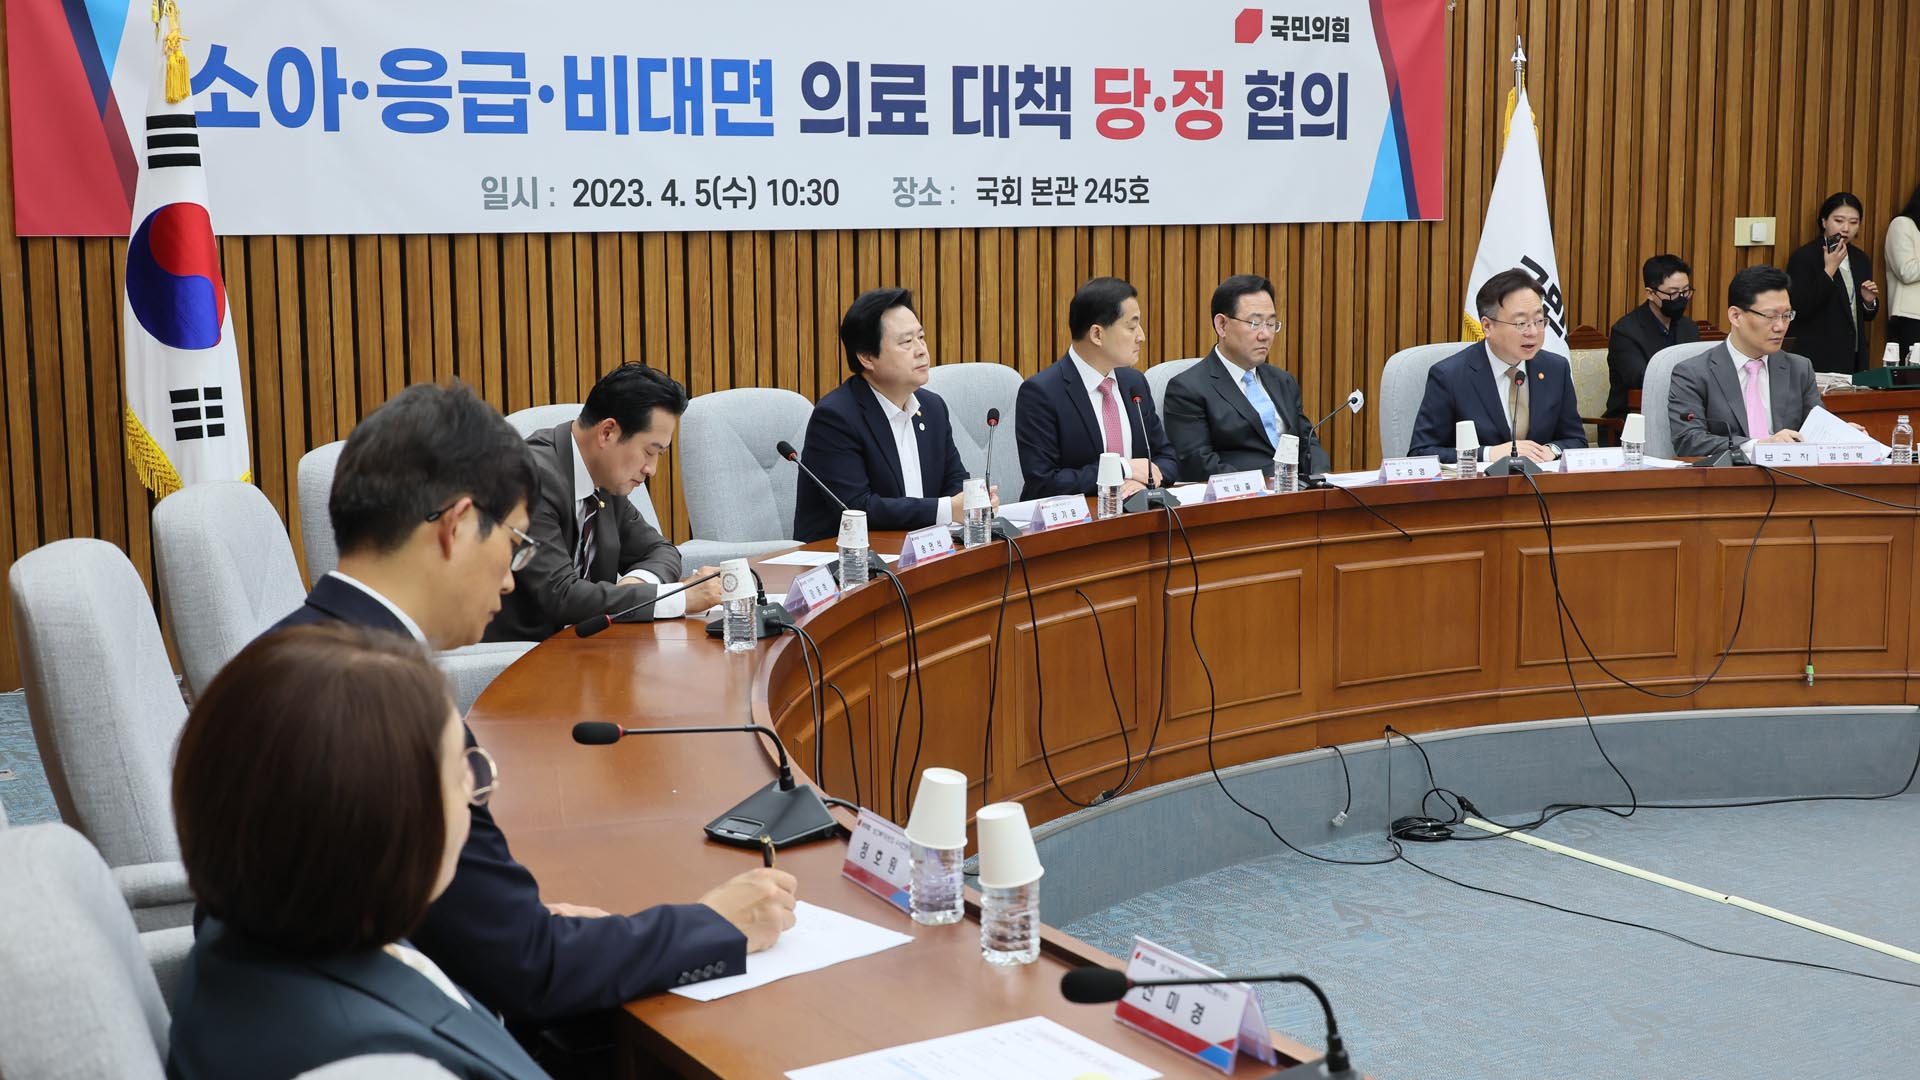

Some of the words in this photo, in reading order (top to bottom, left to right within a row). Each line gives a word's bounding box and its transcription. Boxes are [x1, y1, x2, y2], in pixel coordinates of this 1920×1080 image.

[1269, 15, 1350, 44] 국민의힘
[800, 60, 930, 138] 의료
[951, 63, 1072, 141] 대책
[1094, 67, 1224, 141] 당·정
[1244, 69, 1349, 141] 협의
[481, 175, 538, 211] 일시
[572, 178, 653, 208] 2023.
[660, 178, 686, 207] 4.
[694, 175, 757, 211] 5(수)
[766, 178, 840, 207] 10:30
[892, 176, 942, 208] 장소
[976, 175, 1022, 208] 국회
[1030, 175, 1079, 207] 본관
[1084, 174, 1150, 205] 245호
